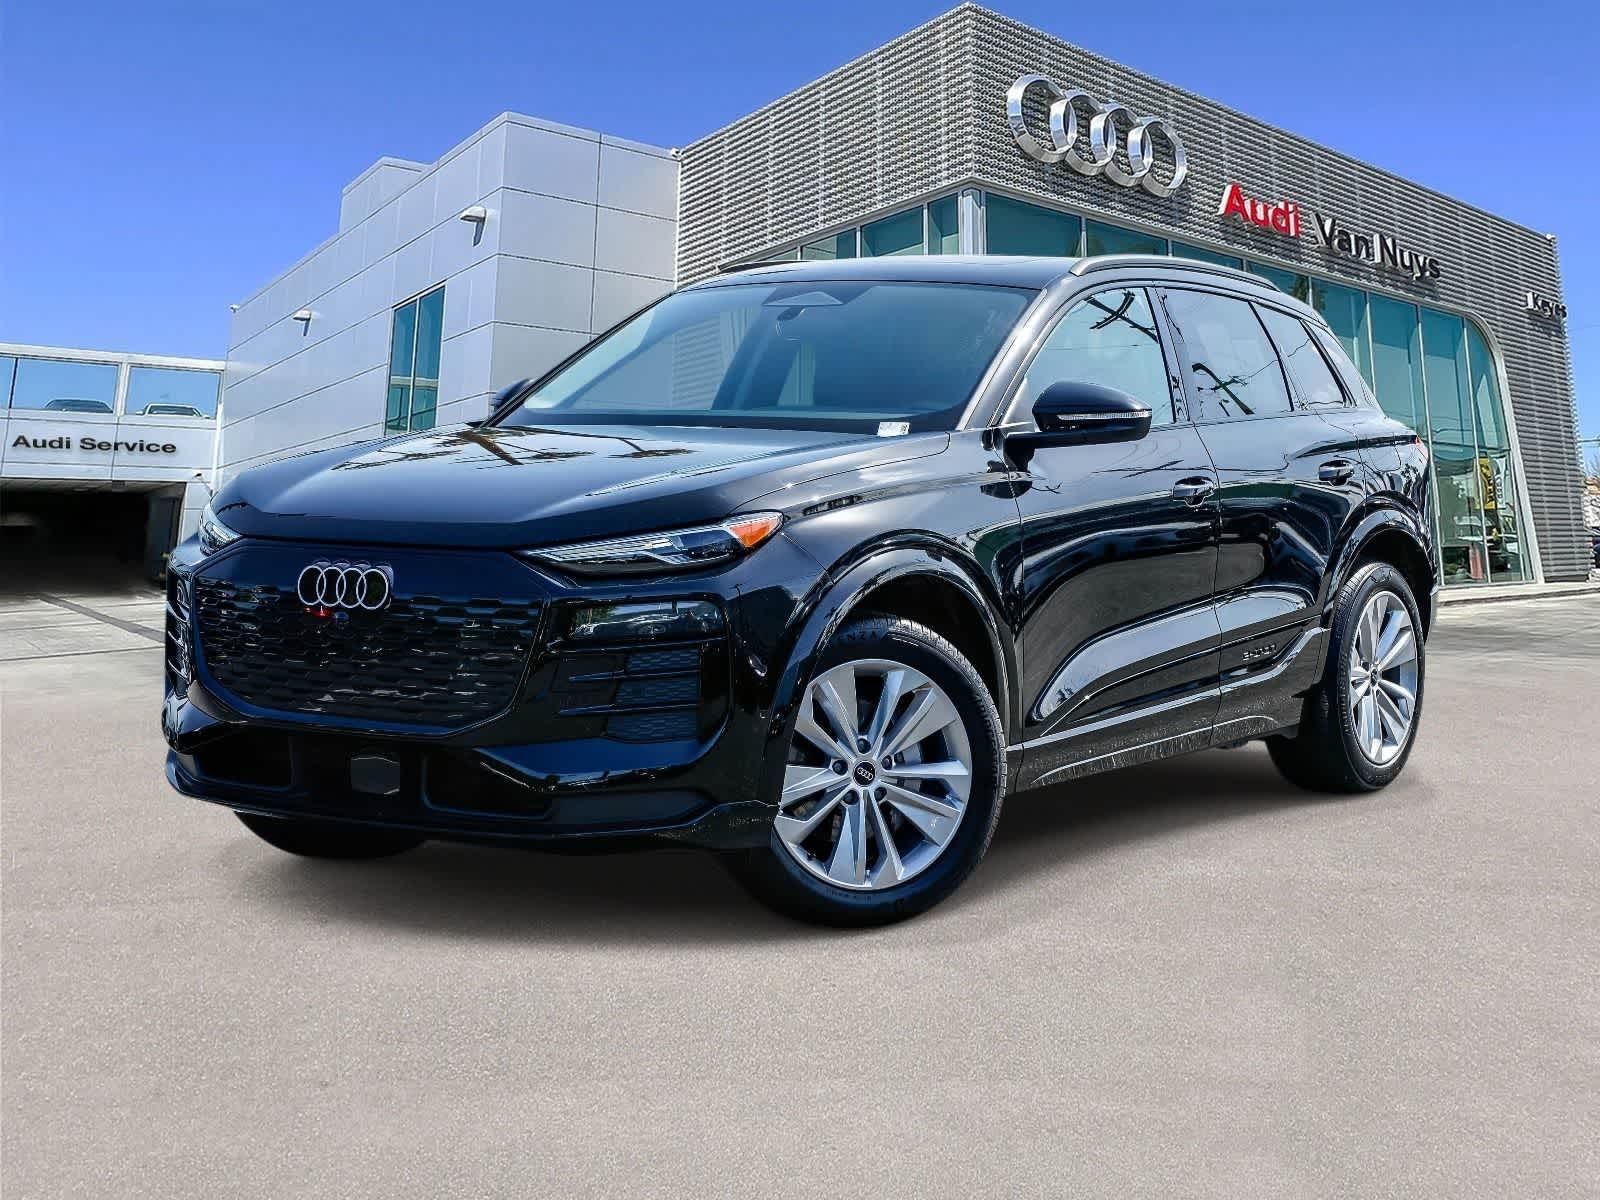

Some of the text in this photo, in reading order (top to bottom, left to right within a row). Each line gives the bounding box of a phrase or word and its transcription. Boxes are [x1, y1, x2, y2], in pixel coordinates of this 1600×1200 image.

[1219, 182, 1442, 281] Audi Van Nuys
[12, 435, 177, 454] Audi Service
